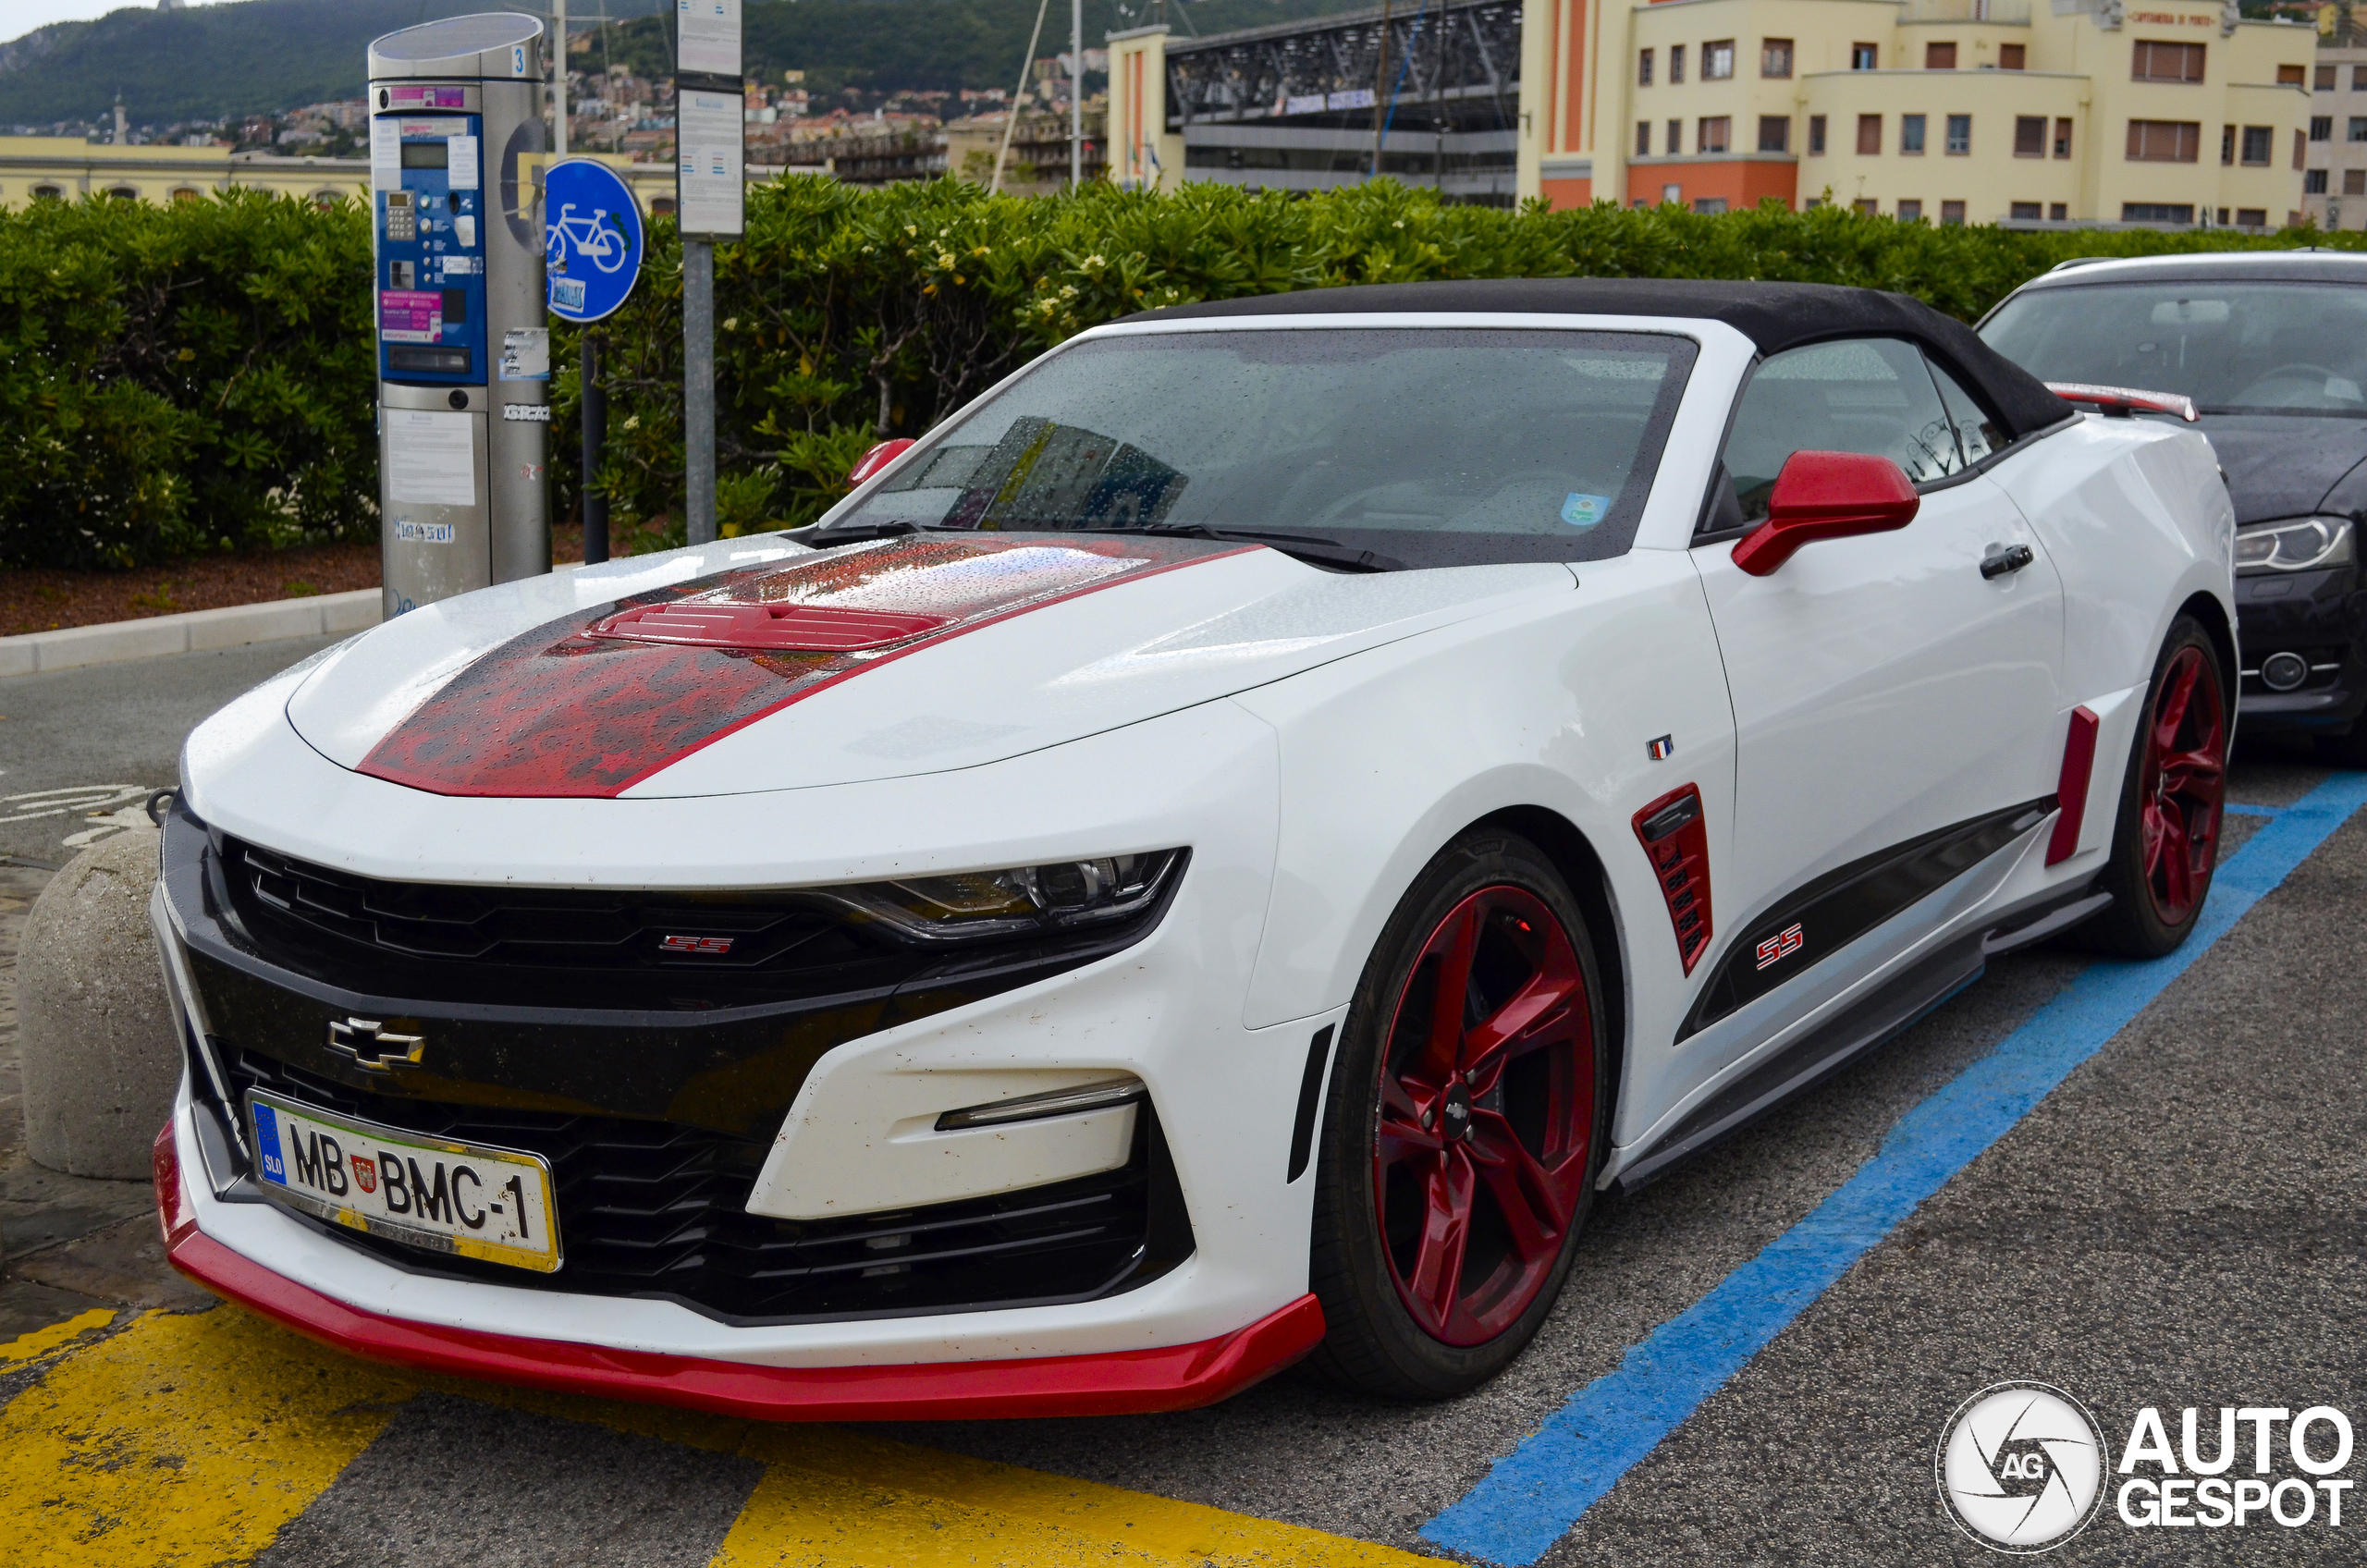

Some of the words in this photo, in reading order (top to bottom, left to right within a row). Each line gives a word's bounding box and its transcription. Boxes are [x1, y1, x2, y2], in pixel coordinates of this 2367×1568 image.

[514, 48, 524, 72] 3
[1474, 841, 1500, 855] OUTSIDE
[658, 935, 734, 953] SS
[1756, 922, 1803, 971] SS
[264, 1154, 283, 1175] SLO
[289, 1122, 350, 1197] MB
[377, 1150, 529, 1239] BMC-1
